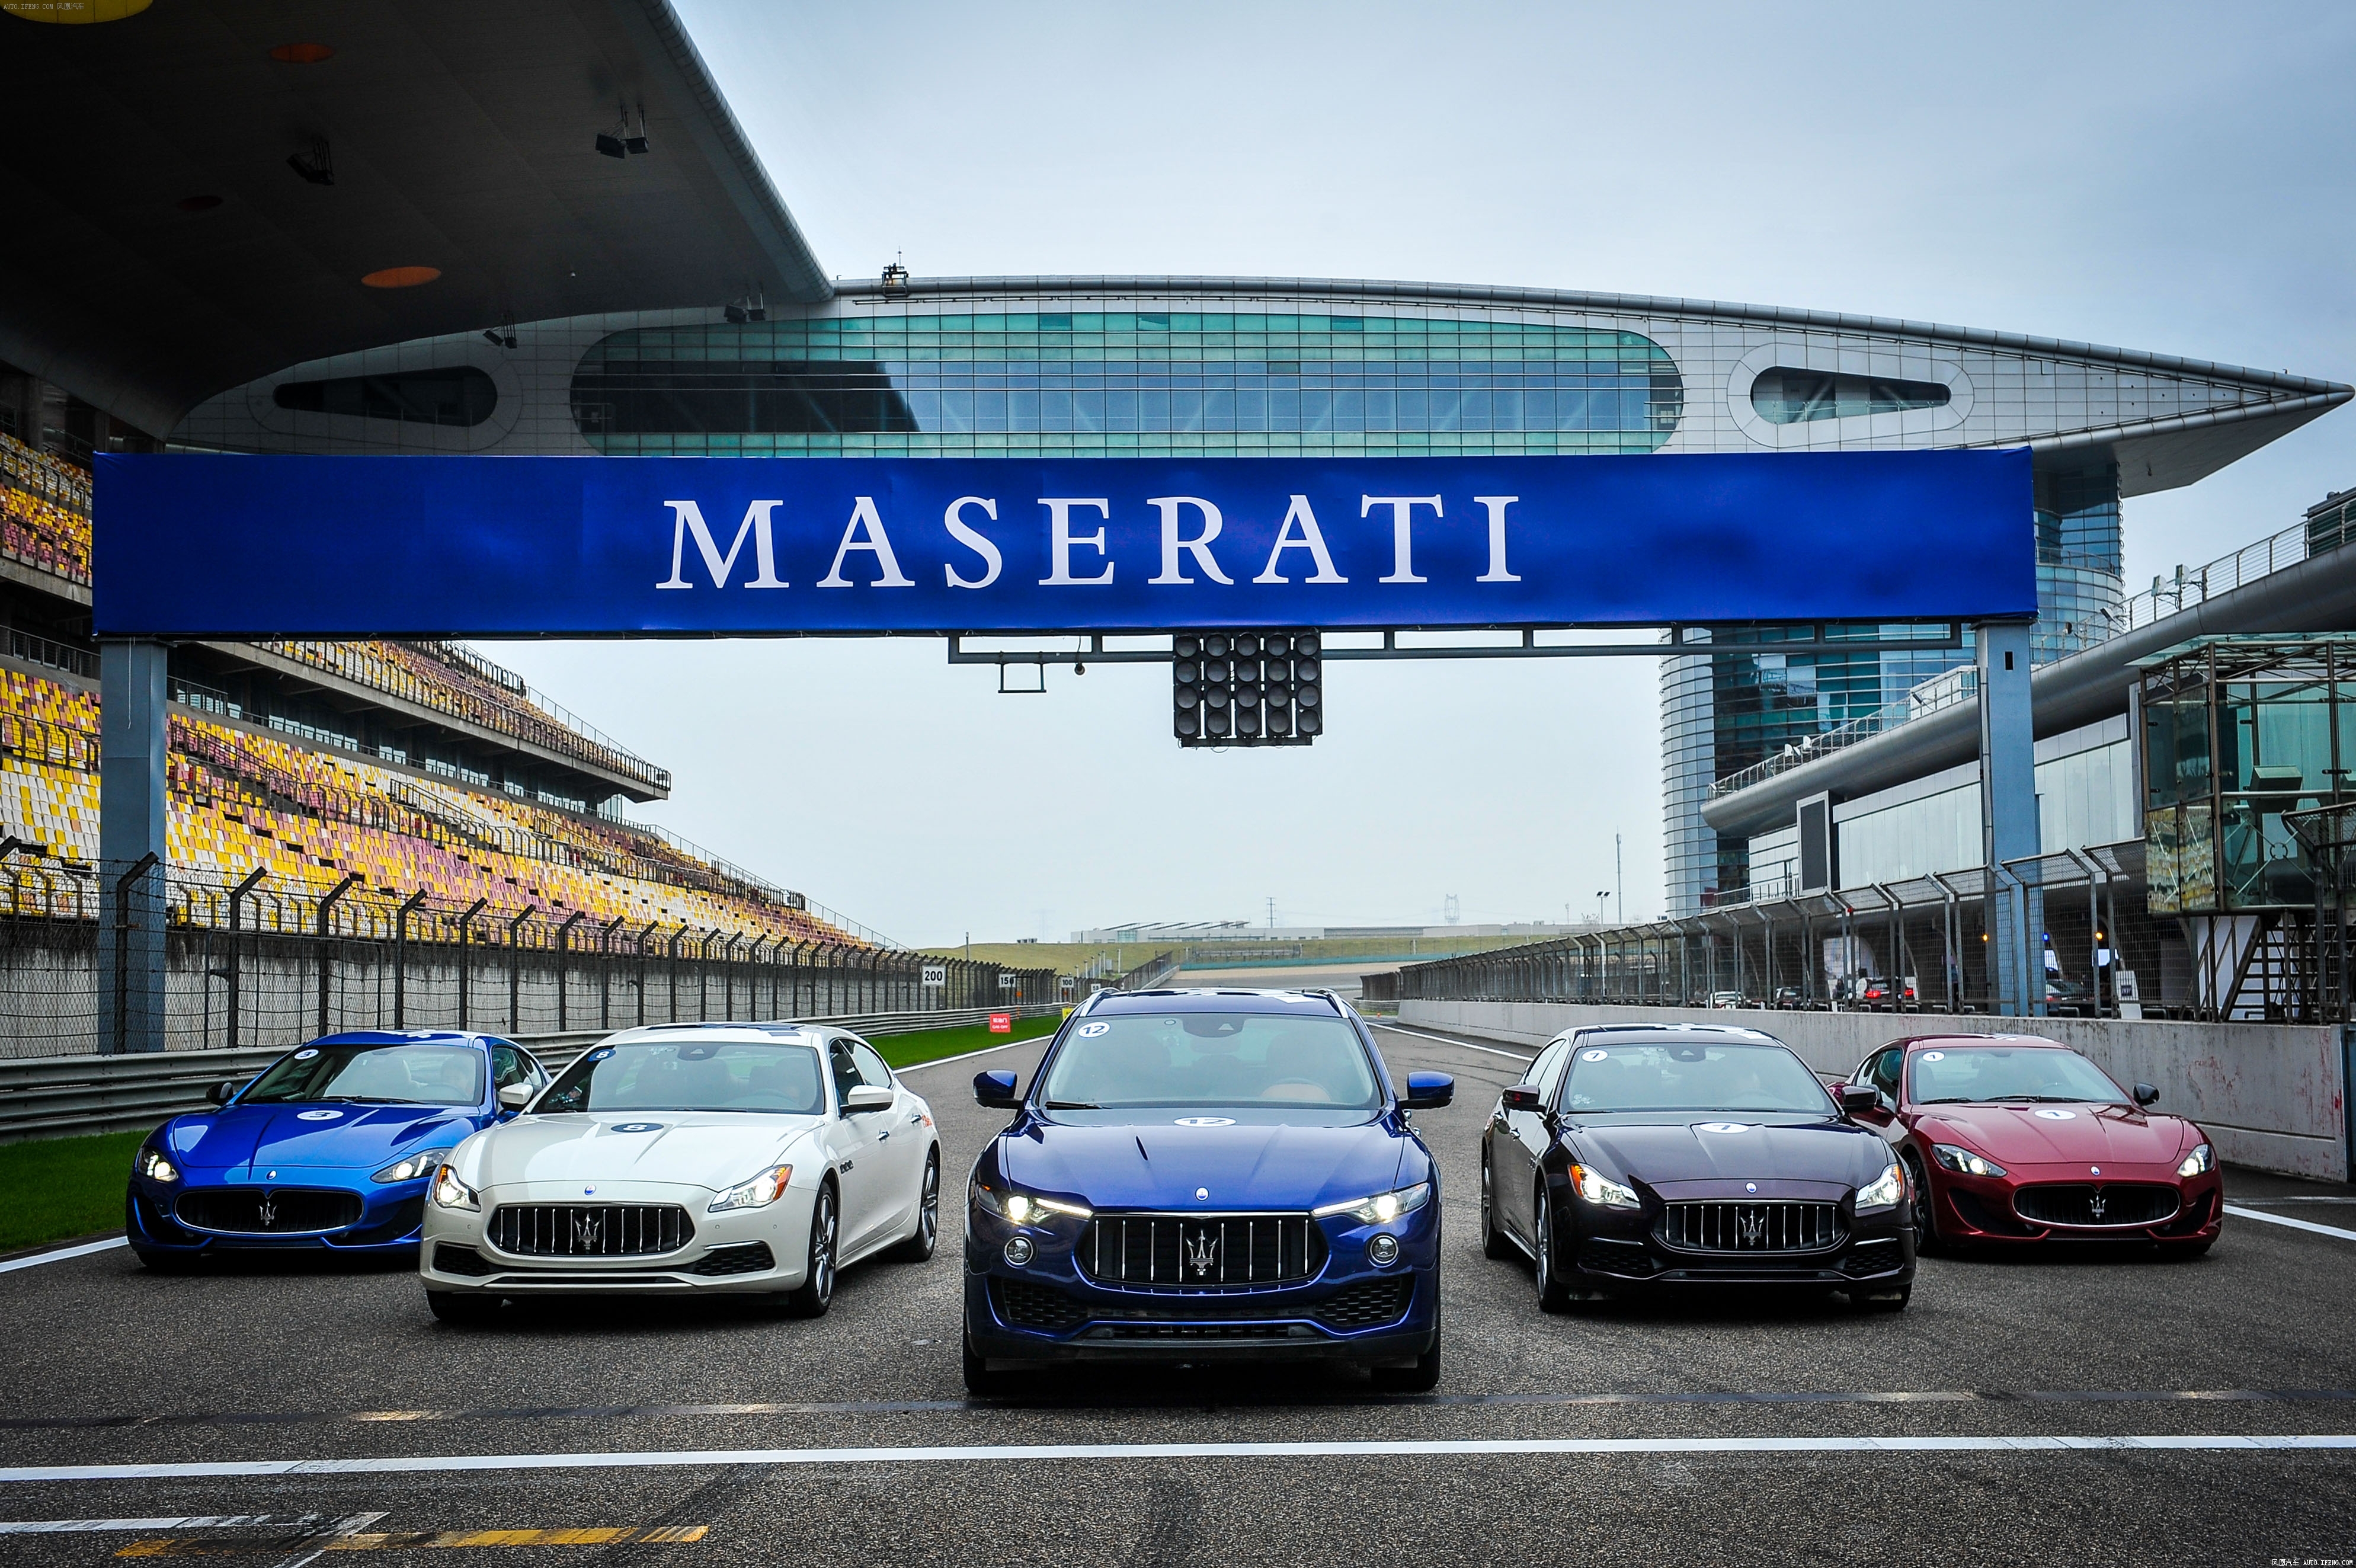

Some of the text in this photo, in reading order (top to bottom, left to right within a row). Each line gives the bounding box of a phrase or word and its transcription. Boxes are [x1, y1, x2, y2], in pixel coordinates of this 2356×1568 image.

[657, 495, 1522, 589] MASERATI
[924, 971, 943, 981] 200
[1083, 1026, 1105, 1034] 12
